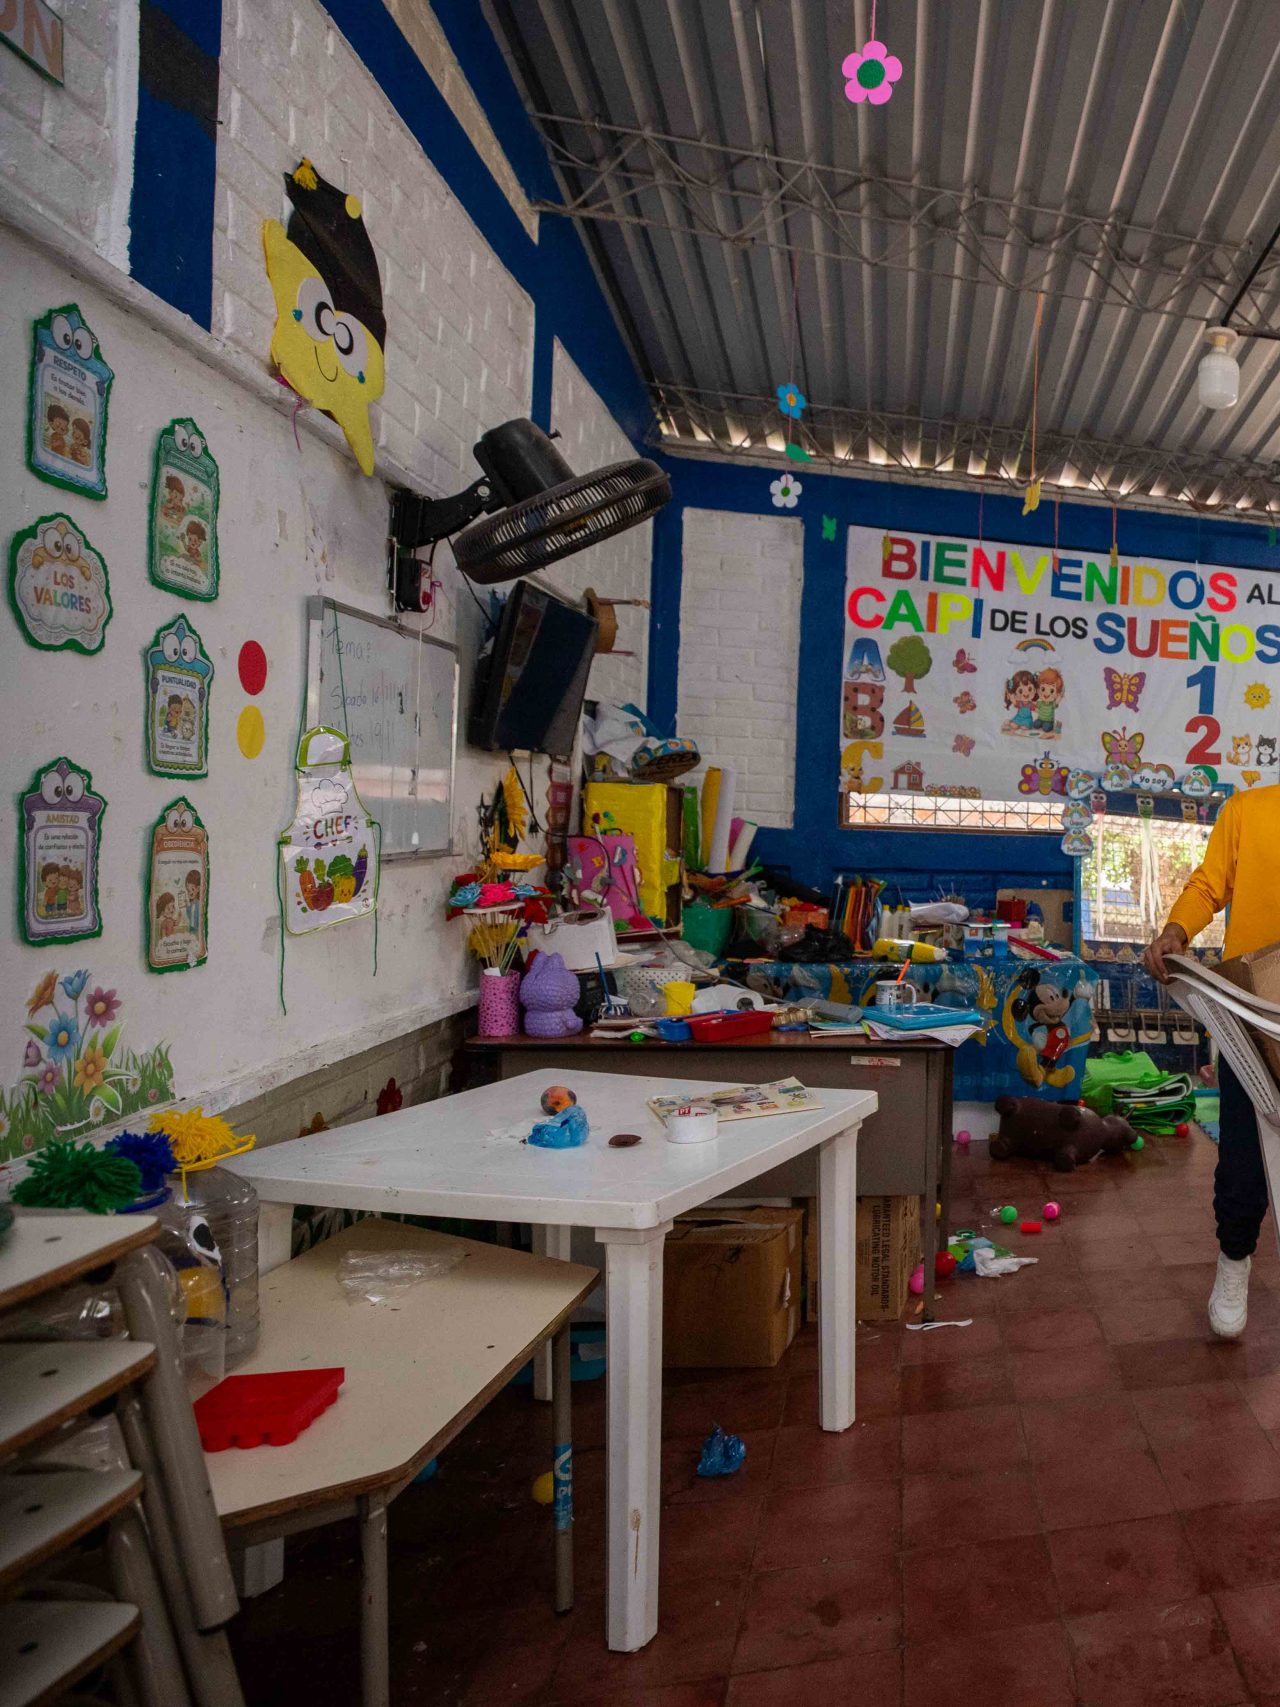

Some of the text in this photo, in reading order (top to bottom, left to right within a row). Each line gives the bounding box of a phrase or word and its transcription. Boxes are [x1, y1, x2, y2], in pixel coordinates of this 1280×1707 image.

[53, 355, 87, 381] RESPETO
[53, 570, 75, 589] LOS
[882, 536, 1238, 612] BIENVENIDOS
[33, 586, 91, 614] VALORES
[847, 586, 984, 639] CAIPI
[990, 608, 1028, 634] DE
[1035, 613, 1088, 639] LOS
[844, 637, 886, 682] A
[161, 674, 197, 690] PUNTUALIDAD
[1186, 665, 1216, 715] 1
[843, 681, 885, 740] B
[1184, 715, 1222, 766] 2
[841, 741, 884, 794] C
[1139, 776, 1167, 787] Yo soy
[46, 814, 80, 824] AMISTAD
[313, 815, 352, 840] CHEF
[882, 1196, 891, 1238] ARANTEED
[871, 1205, 880, 1296] LUBRICATING MOTOR OIL
[881, 1240, 890, 1262] LEGAL
